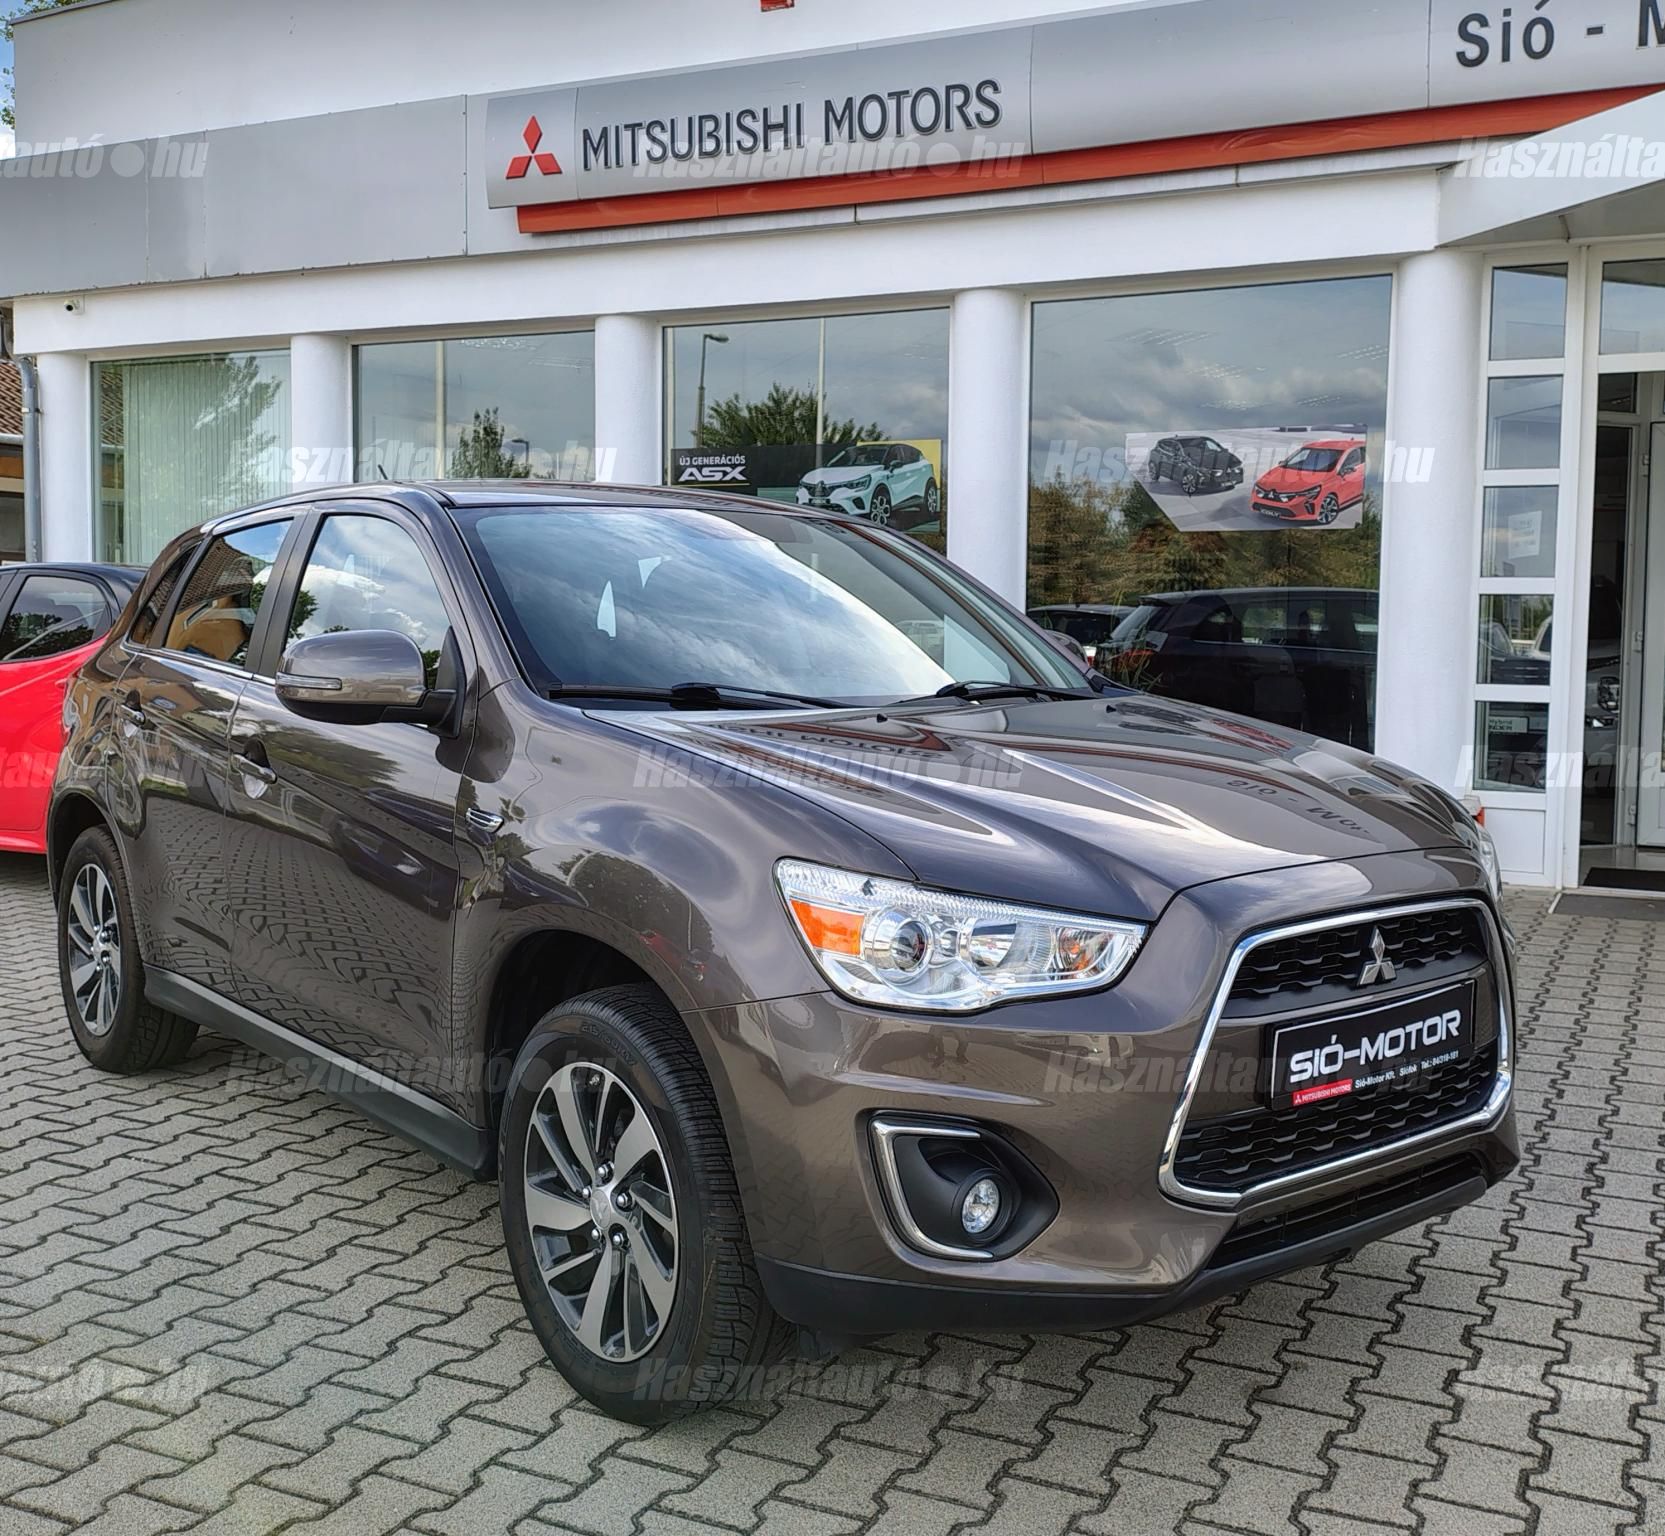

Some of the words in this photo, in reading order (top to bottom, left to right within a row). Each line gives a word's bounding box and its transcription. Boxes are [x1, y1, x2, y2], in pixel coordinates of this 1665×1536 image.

[1456, 0, 1555, 67] Sió
[582, 101, 805, 172] MITSUBISHI
[823, 79, 1002, 146] MOTORS
[678, 465, 748, 482] ASX
[692, 453, 746, 466] GENERÁCIÓS
[1290, 1009, 1461, 1083] SIÓ-MOTOR
[1301, 1088, 1331, 1101] MITSUBISHI
[1330, 1083, 1352, 1096] MOTORS
